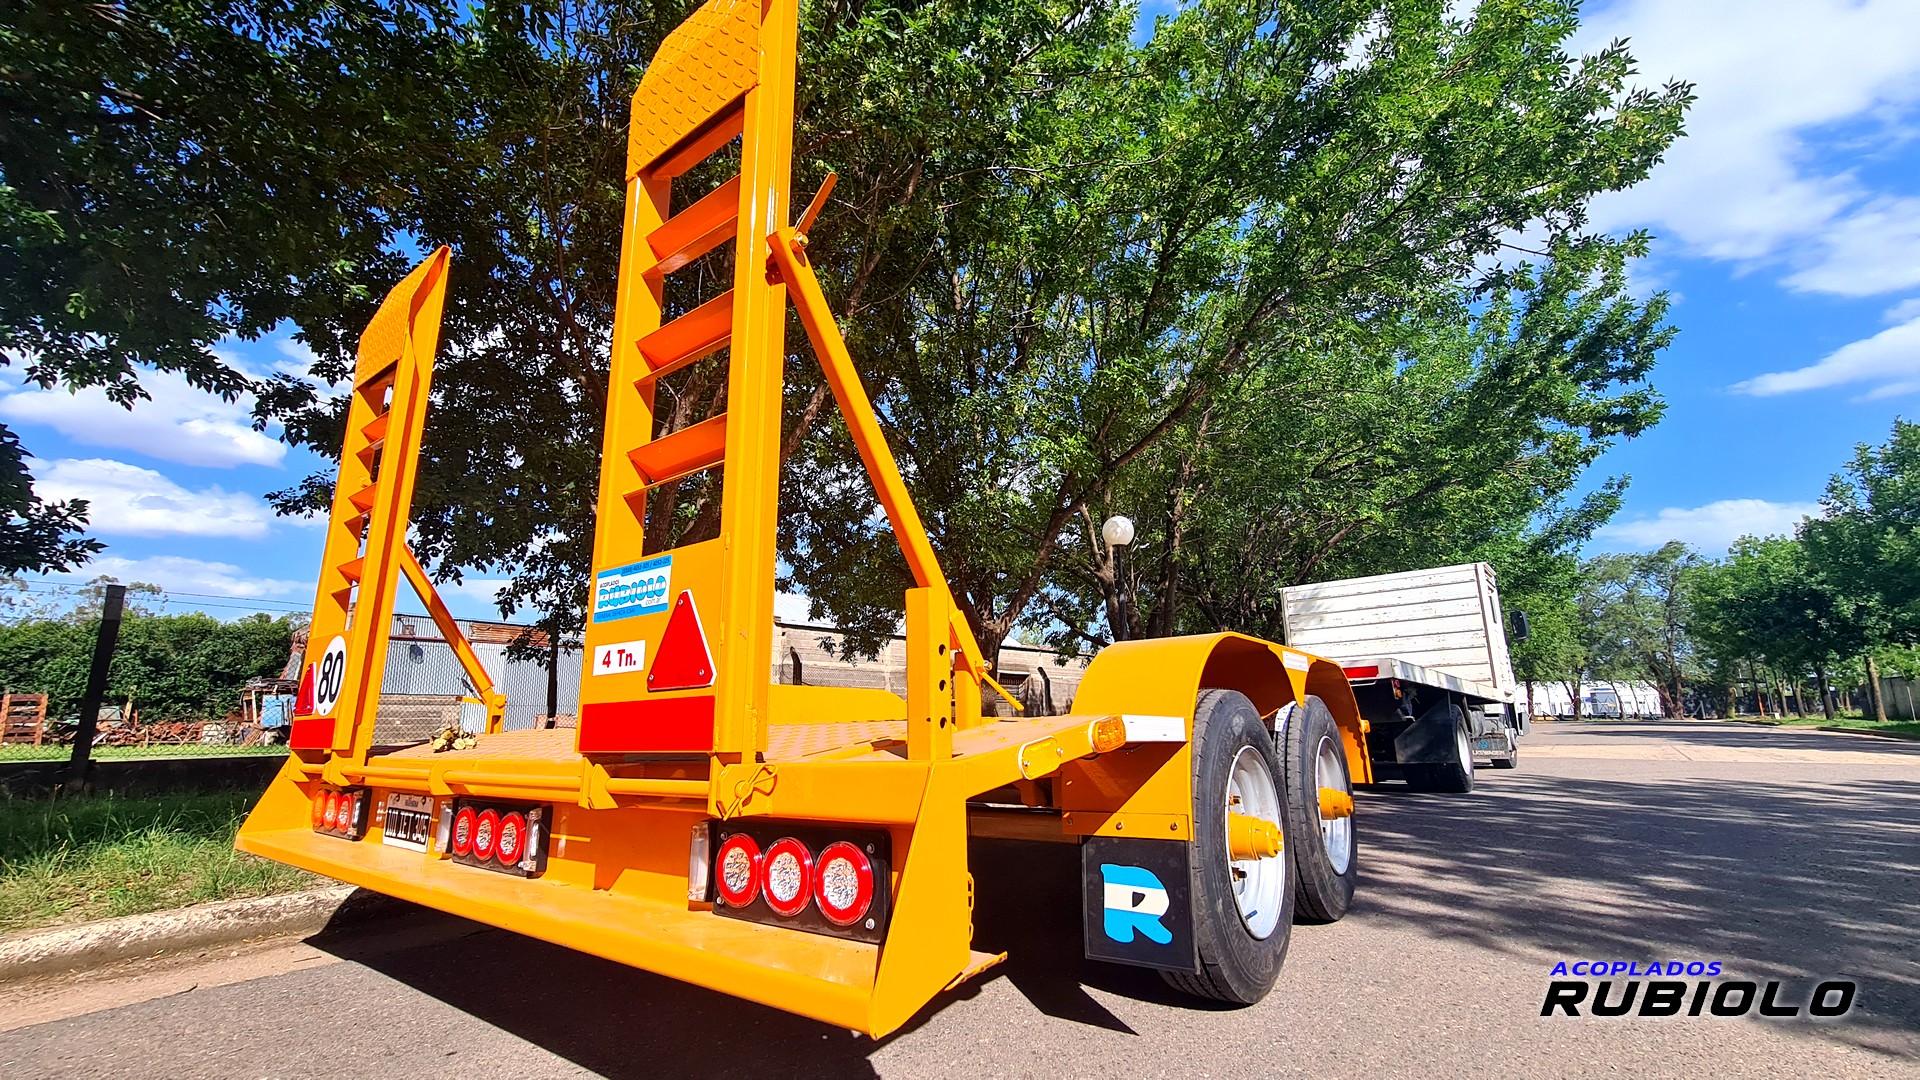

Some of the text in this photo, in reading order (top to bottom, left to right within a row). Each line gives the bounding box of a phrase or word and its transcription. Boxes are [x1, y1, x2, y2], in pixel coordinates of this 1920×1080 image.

[598, 575, 667, 609] RUBIOLO
[318, 650, 344, 704] 80
[602, 649, 637, 668] 4 Tn.
[1100, 863, 1174, 945] R
